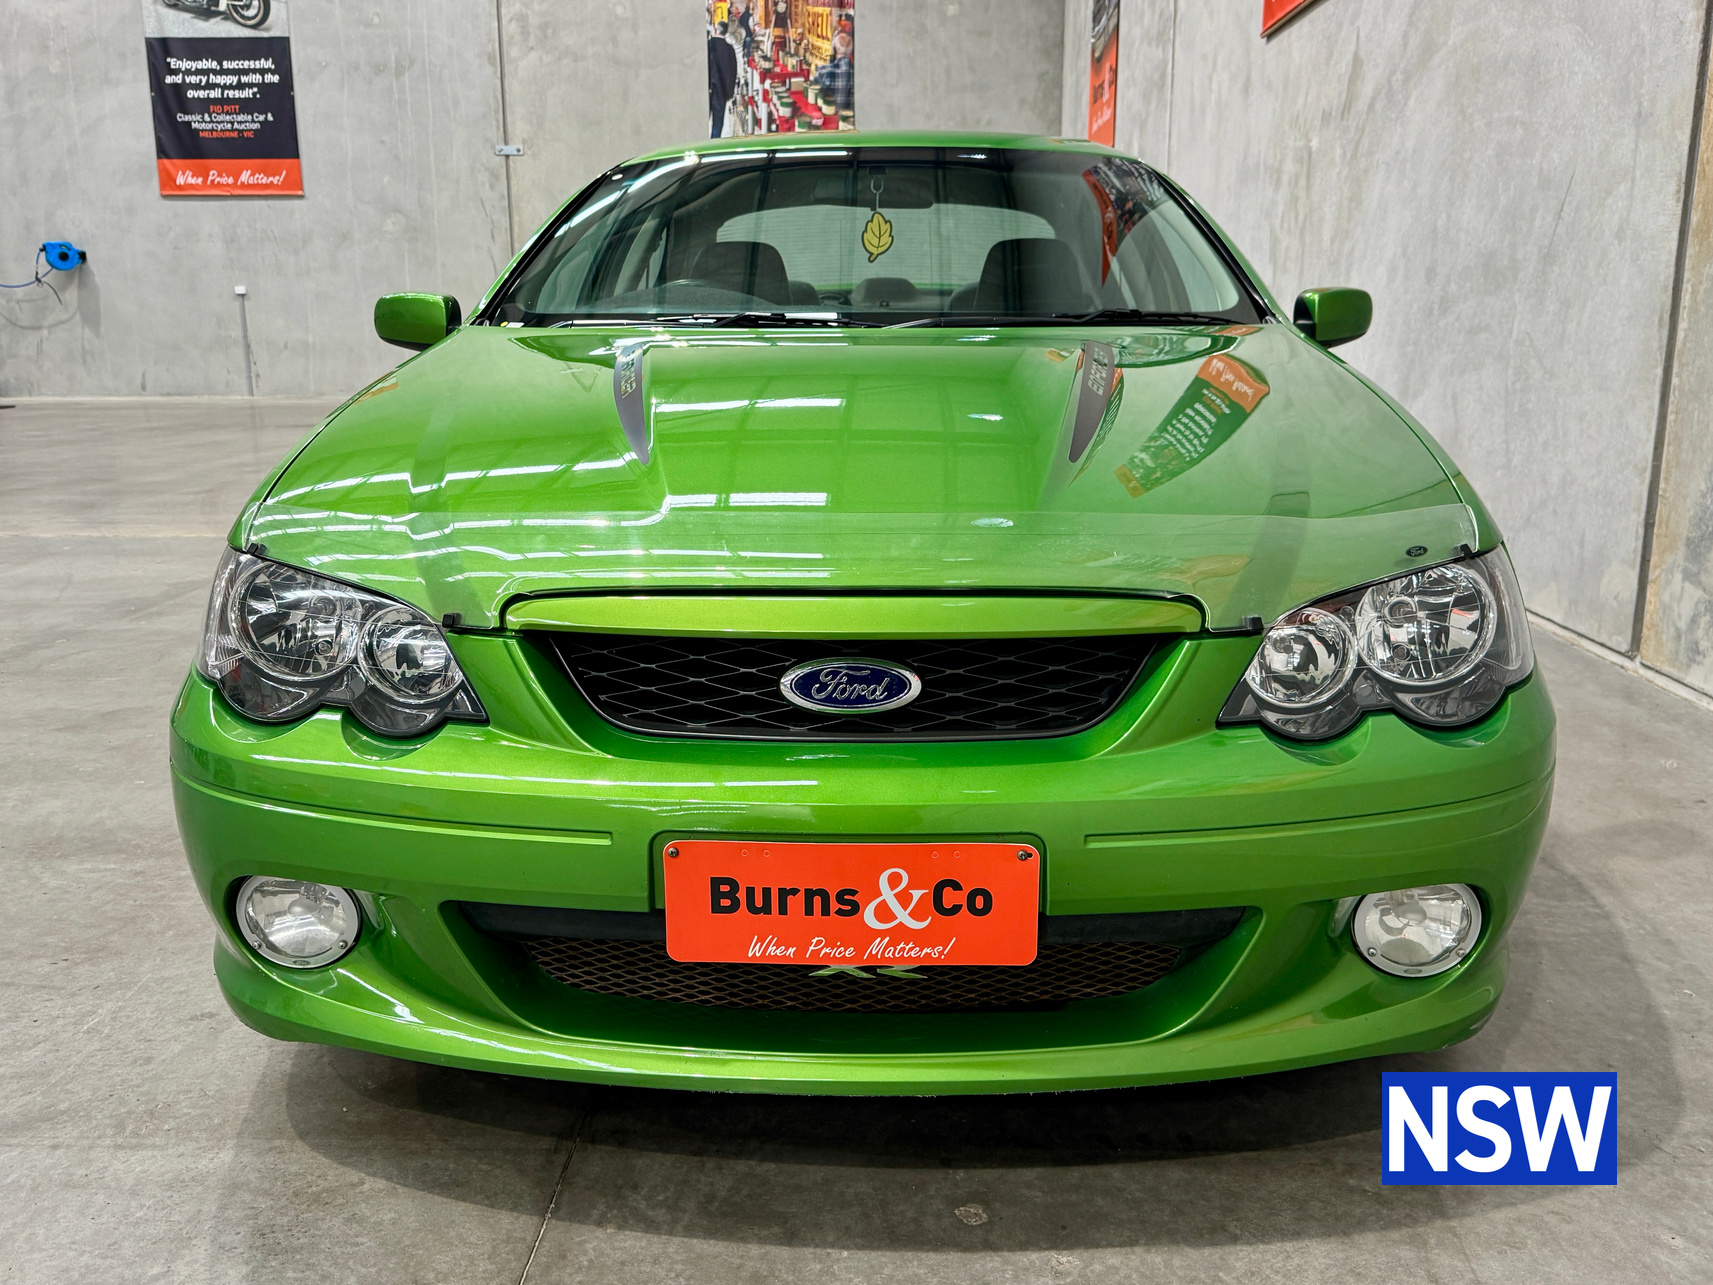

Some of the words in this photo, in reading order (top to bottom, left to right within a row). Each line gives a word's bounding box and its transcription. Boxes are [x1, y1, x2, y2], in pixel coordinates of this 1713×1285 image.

[222, 58, 275, 70] successful,
[165, 73, 182, 84] and
[185, 75, 207, 86] very
[209, 73, 239, 86] happy
[240, 73, 262, 84] with
[264, 72, 280, 83] the
[187, 87, 221, 98] overall
[223, 105, 239, 113] PITT
[176, 113, 203, 122] Classic
[204, 113, 211, 121] &
[211, 113, 252, 122] Collectable
[253, 113, 266, 121] Car
[267, 112, 274, 121] &
[191, 122, 232, 131] Motorcycle
[233, 122, 261, 130] Auction
[175, 170, 203, 186] When
[207, 170, 234, 185] Price
[237, 169, 286, 185] Matters!
[811, 668, 890, 700] Ford
[747, 935, 797, 959] When
[805, 937, 855, 959] Price
[863, 936, 956, 960] Matters!
